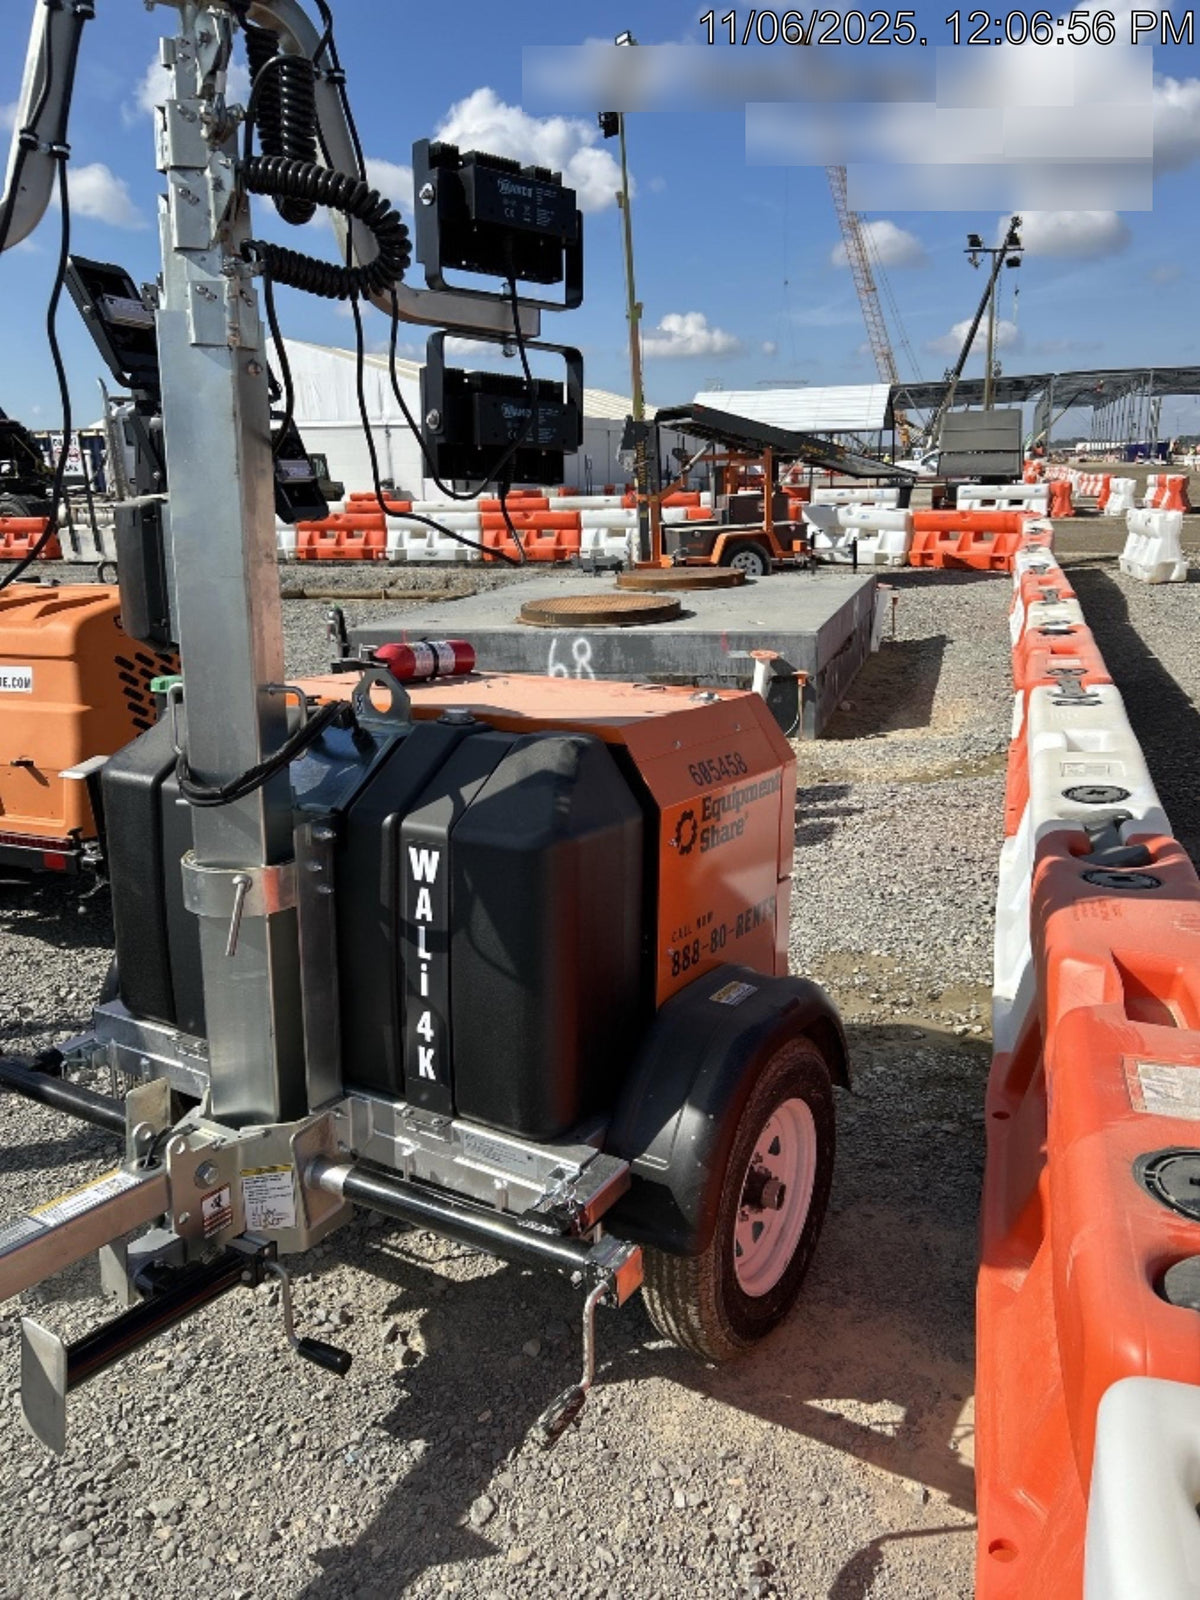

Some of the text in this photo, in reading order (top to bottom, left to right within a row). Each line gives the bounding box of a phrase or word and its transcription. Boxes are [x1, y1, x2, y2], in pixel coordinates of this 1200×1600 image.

[0, 676, 31, 688] E.COM
[688, 751, 748, 787] 605458
[701, 770, 781, 822] Equipment
[700, 817, 745, 853] Share
